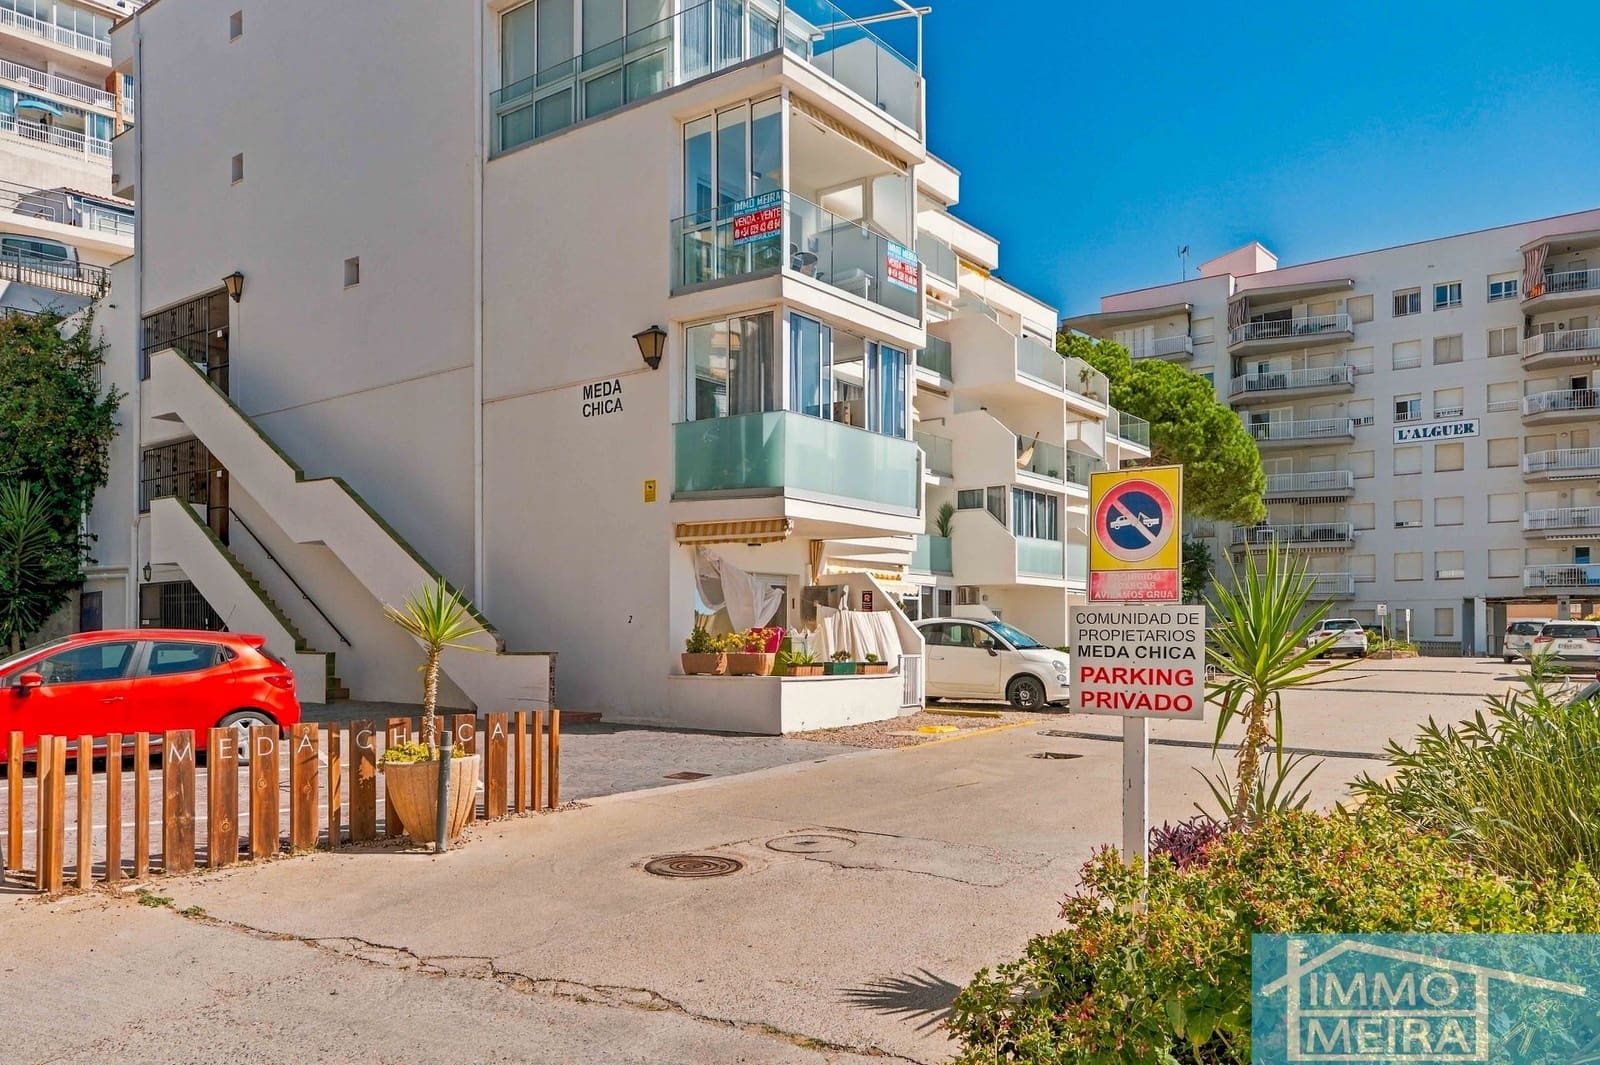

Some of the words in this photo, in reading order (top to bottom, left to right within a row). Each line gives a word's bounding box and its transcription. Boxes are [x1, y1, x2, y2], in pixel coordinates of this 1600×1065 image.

[734, 199, 755, 212] IMMO
[757, 191, 781, 205] MEIRA
[735, 213, 756, 228] VENDA
[760, 207, 781, 221] VENTE
[583, 379, 622, 400] MEDA
[582, 398, 623, 418] CHICA
[1398, 423, 1474, 440] L'ALGUER
[1146, 590, 1174, 599] GRUA
[1076, 612, 1172, 625] COMUNIDAD
[1177, 612, 1200, 625] DE
[1079, 629, 1196, 643] PROPIETARIOS
[1078, 645, 1130, 659] MEDA
[1135, 646, 1196, 660] CHICA
[1080, 666, 1194, 687] PARKING
[1081, 691, 1193, 712] PRIVADO
[356, 722, 505, 749] CHCA
